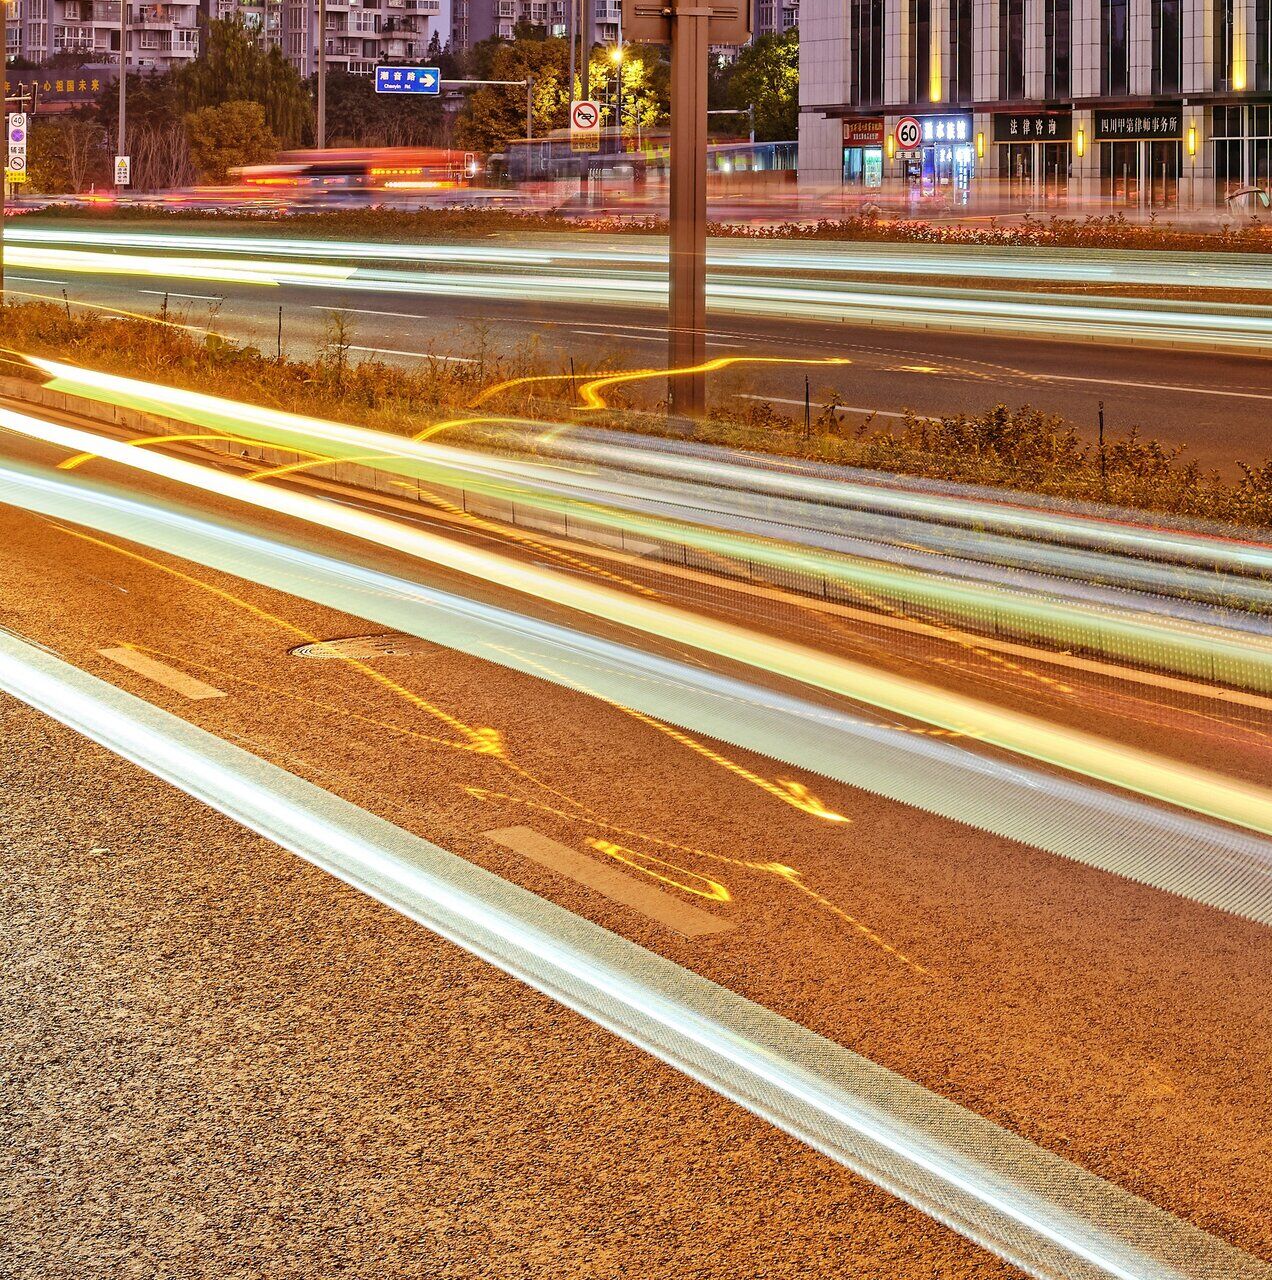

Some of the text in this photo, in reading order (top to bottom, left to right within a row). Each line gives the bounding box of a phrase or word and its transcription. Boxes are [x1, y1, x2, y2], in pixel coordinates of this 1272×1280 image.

[901, 124, 917, 142] 60
[1009, 118, 1057, 135] 法律咨询
[1101, 116, 1178, 133] 四川甲第律师事务所
